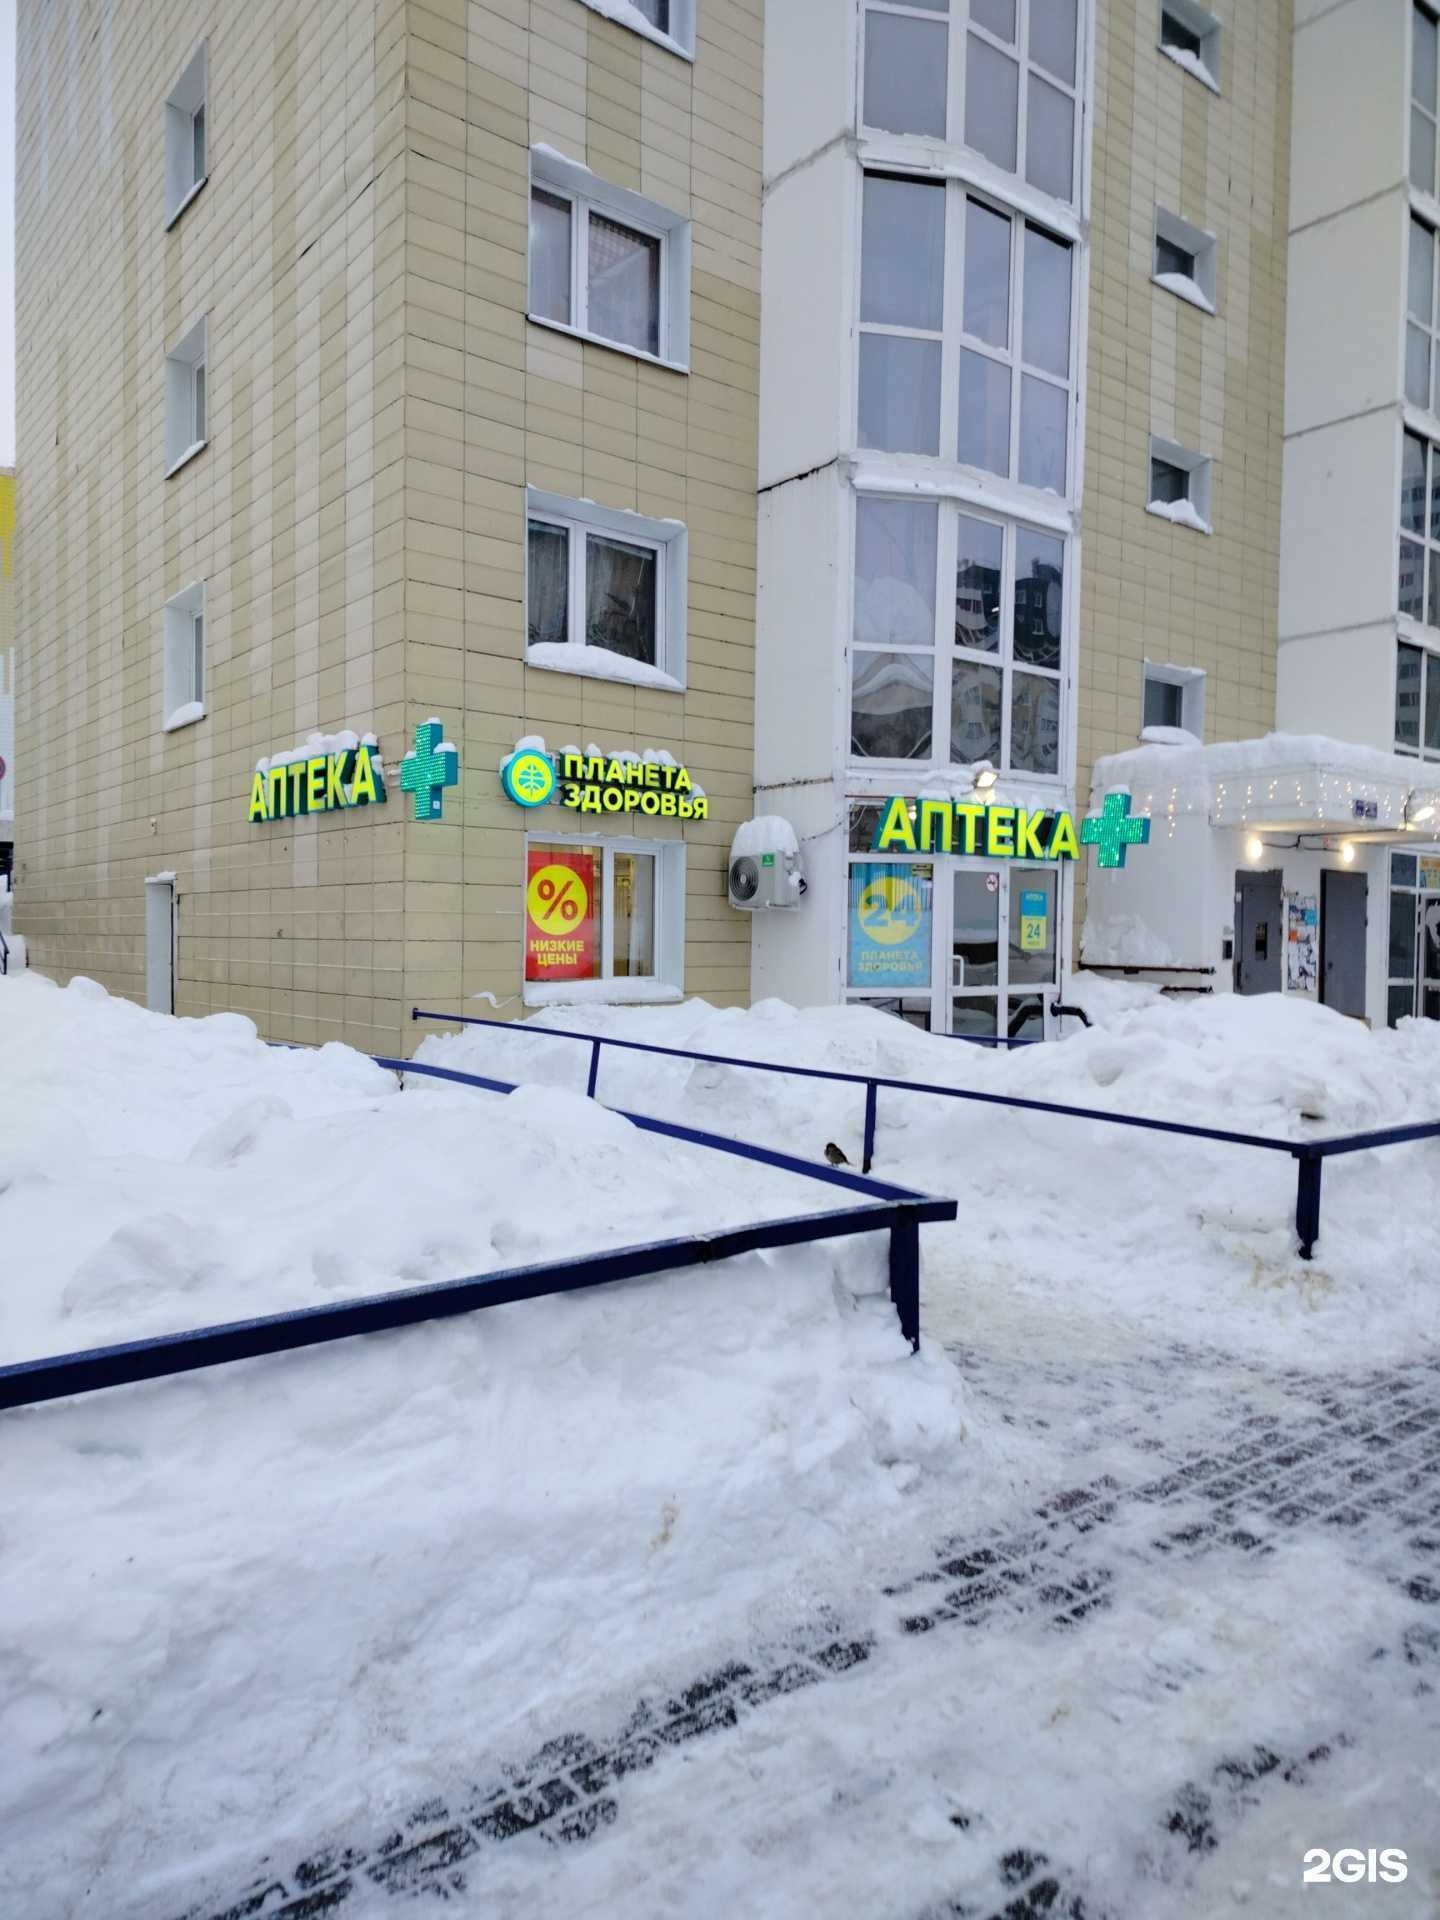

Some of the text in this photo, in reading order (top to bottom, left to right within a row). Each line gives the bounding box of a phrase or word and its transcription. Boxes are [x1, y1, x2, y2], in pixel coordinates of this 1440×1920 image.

[248, 746, 377, 822] АПТЕКА
[564, 754, 692, 792] ПЛАНЕТА
[564, 783, 708, 819] ЗДОРОВЬЯ
[877, 796, 1080, 860] АПТЕКА
[530, 939, 584, 952] НИЗКИЕ
[1026, 923, 1040, 938] 24
[537, 953, 577, 967] ЦЕНЫ
